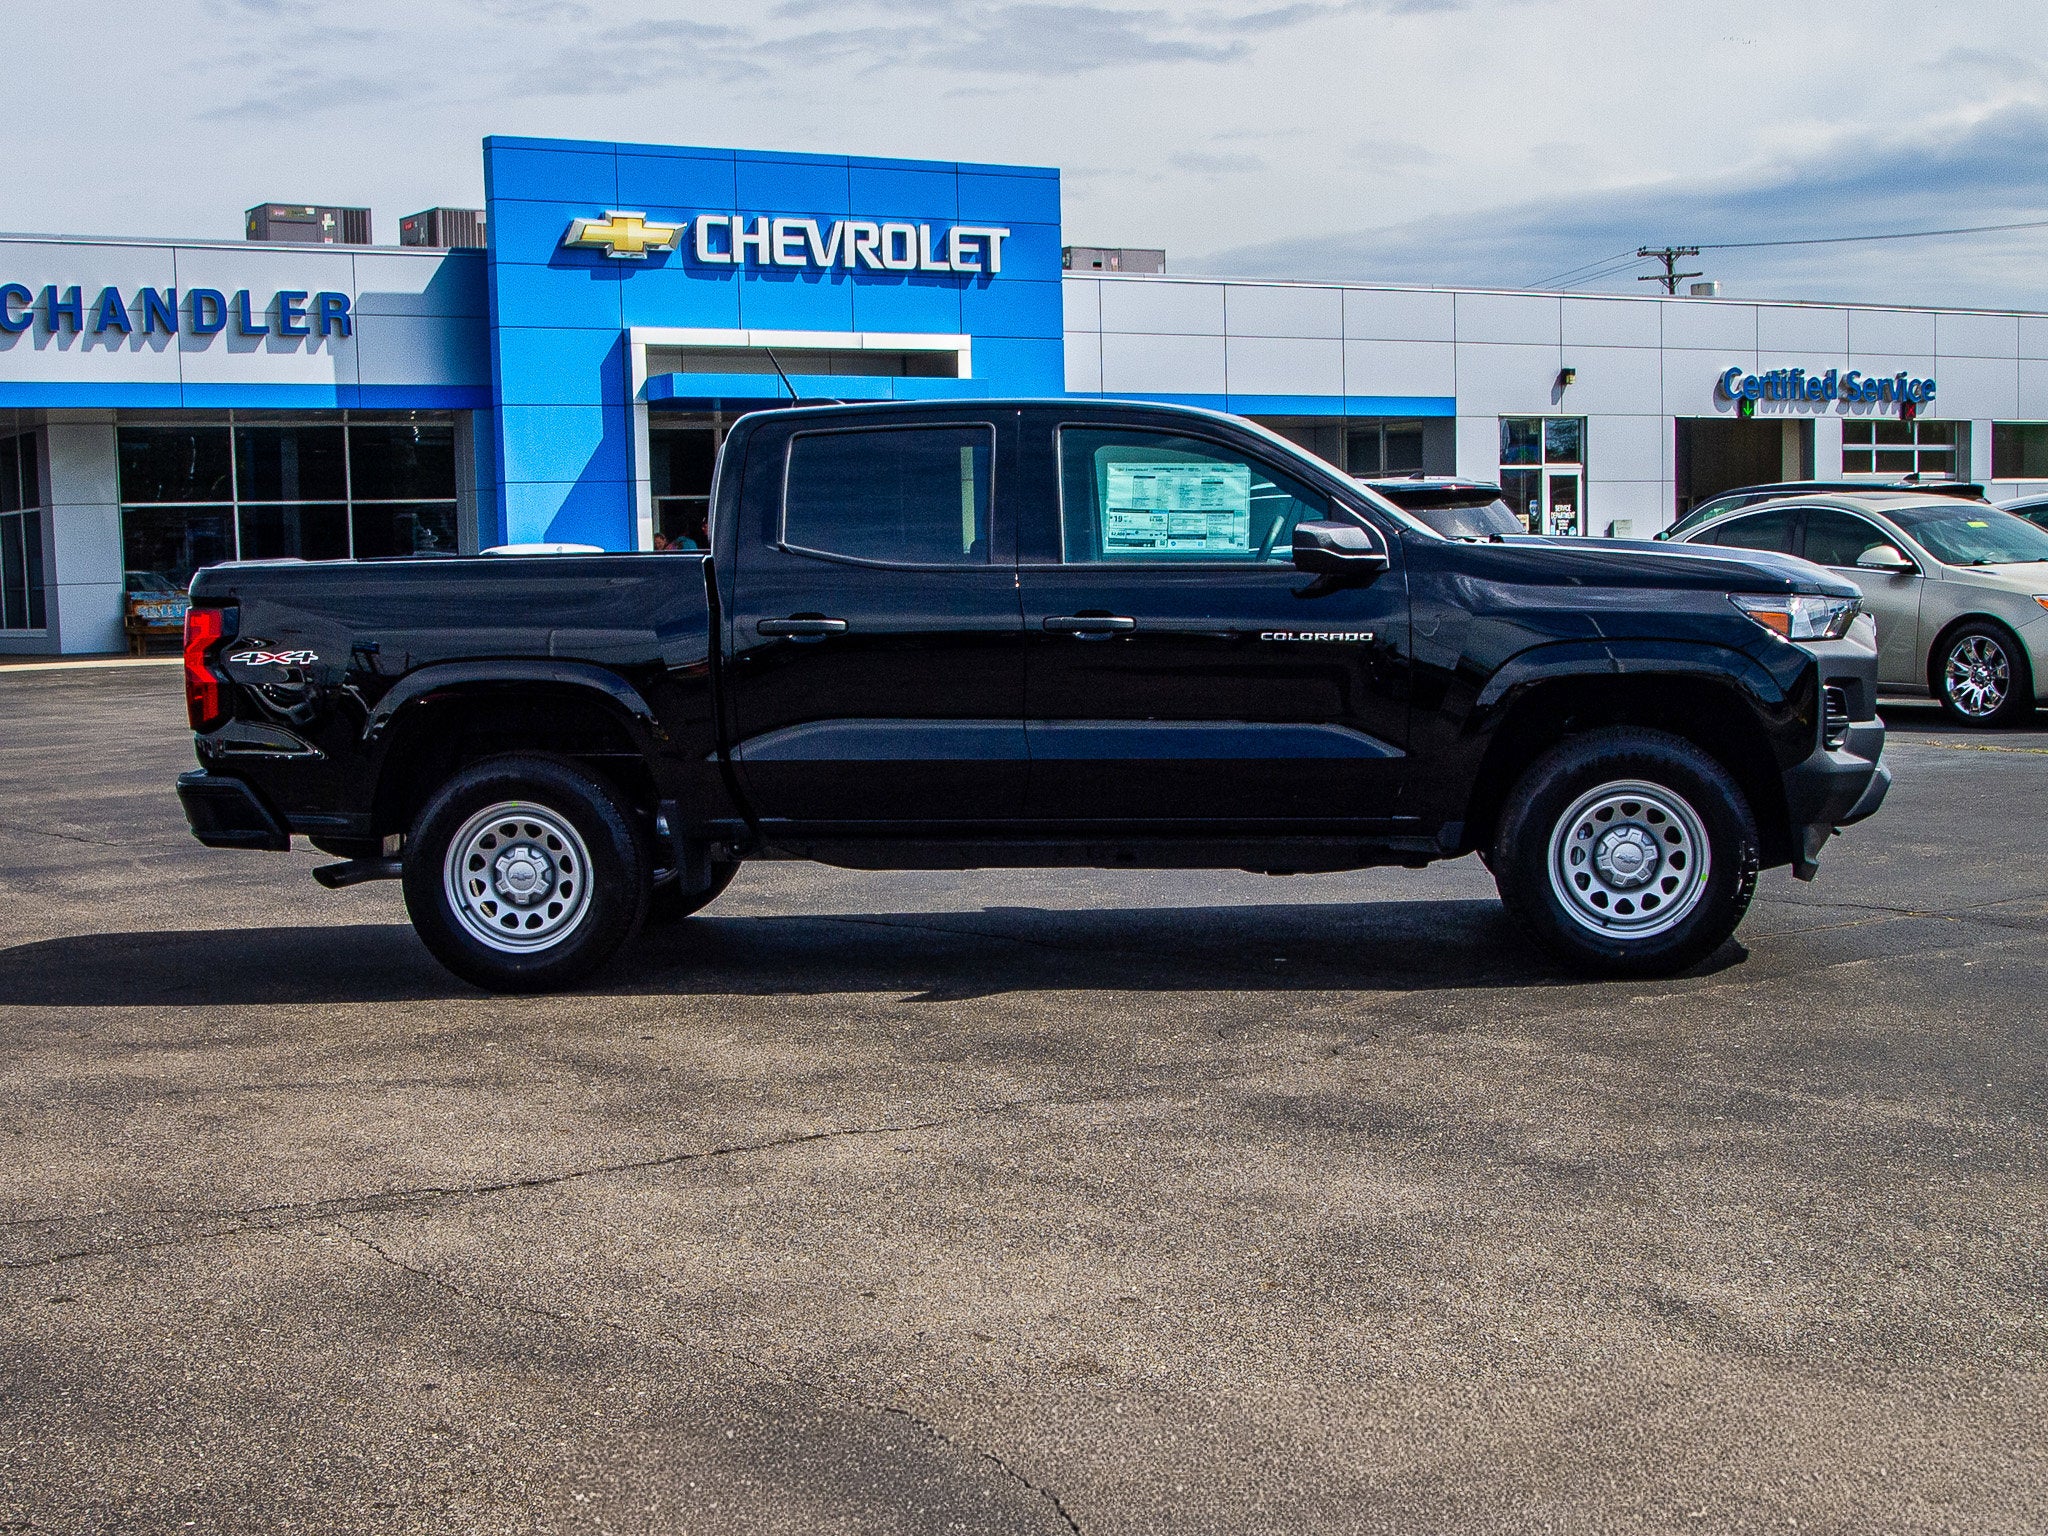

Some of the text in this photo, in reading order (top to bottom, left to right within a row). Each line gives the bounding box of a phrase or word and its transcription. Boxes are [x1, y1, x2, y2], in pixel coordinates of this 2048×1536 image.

[695, 214, 1011, 273] CHEVROLET
[0, 283, 353, 337] CHANDLER
[1723, 366, 1936, 402] Certified Service
[1550, 511, 1576, 519] DEPARTMENT
[1554, 504, 1571, 512] SERVICE
[1260, 632, 1374, 641] COLORADO
